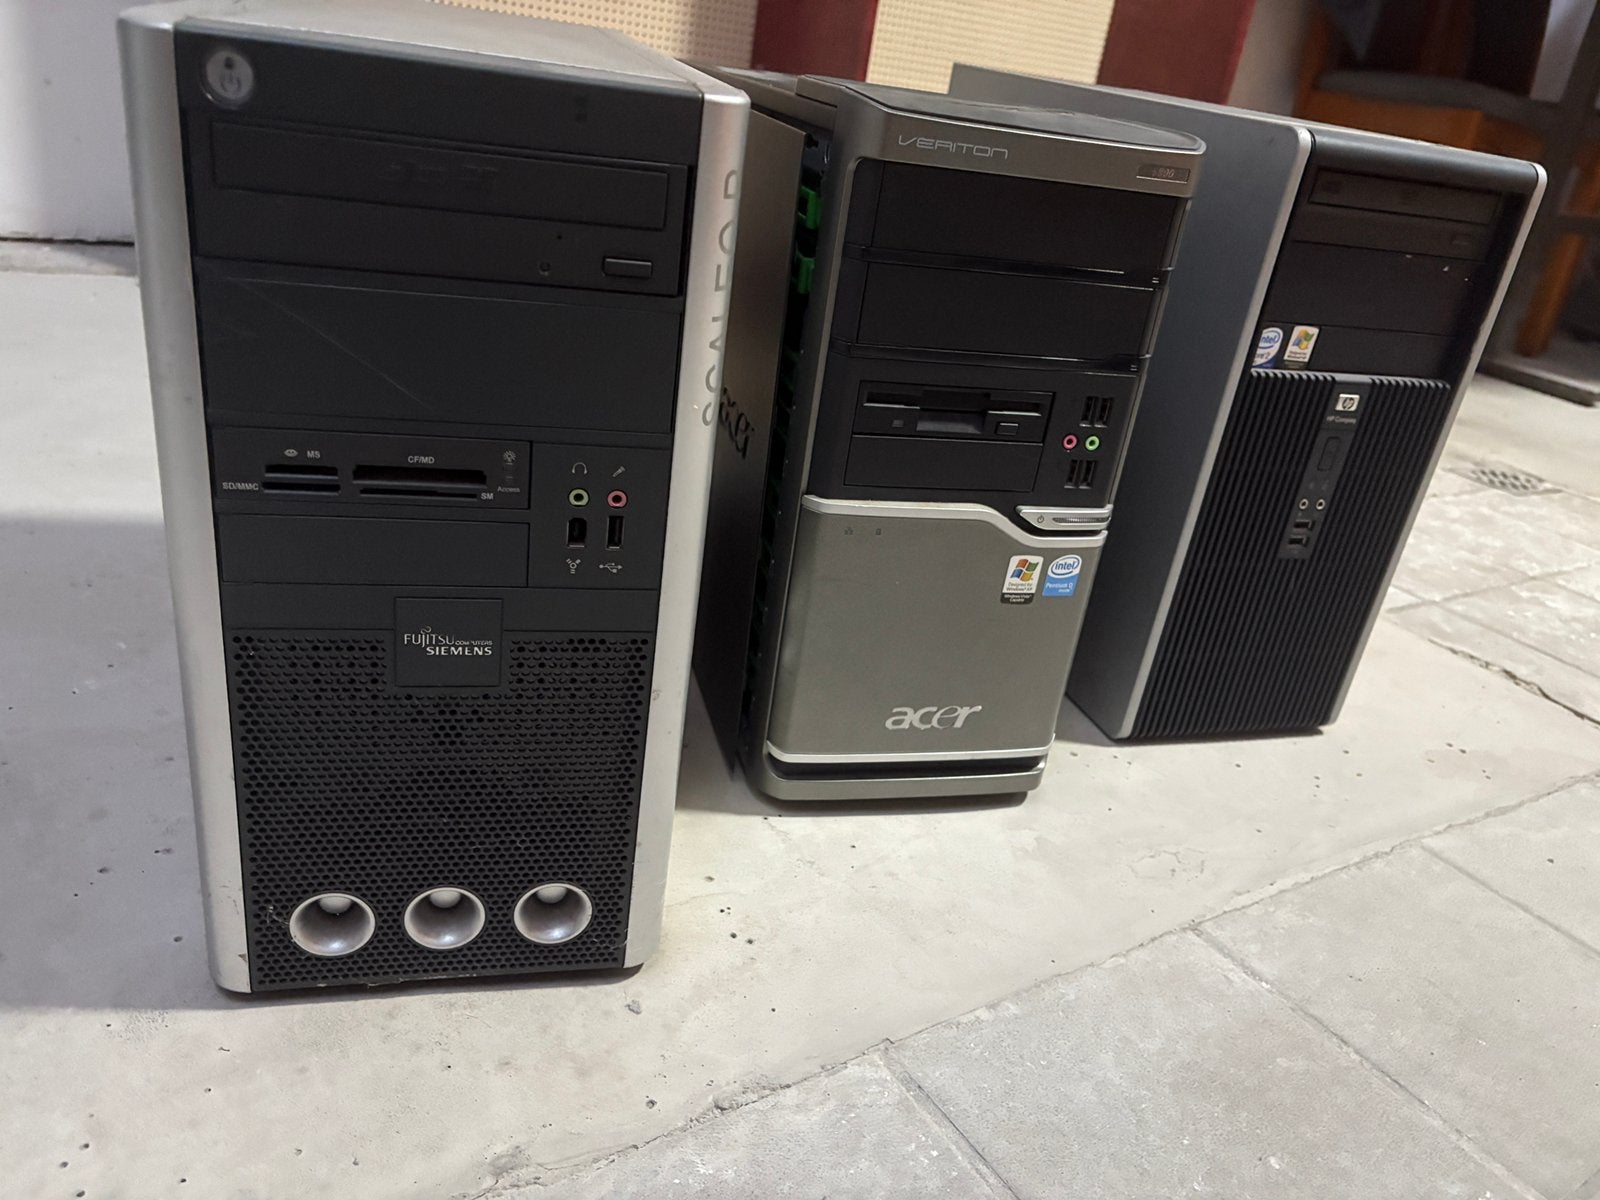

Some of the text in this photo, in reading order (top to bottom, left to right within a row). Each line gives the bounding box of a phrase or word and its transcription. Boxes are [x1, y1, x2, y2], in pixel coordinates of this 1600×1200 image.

[898, 134, 1009, 160] VERITON
[306, 450, 321, 460] MS
[407, 455, 436, 465] CF/MD
[222, 481, 259, 491] SD/MMC
[497, 485, 521, 493] Access
[480, 492, 494, 501] SM
[1054, 561, 1076, 571] intel
[404, 627, 454, 648] FUJITSU
[426, 646, 493, 656] SIEMENS
[885, 705, 983, 731] acer
